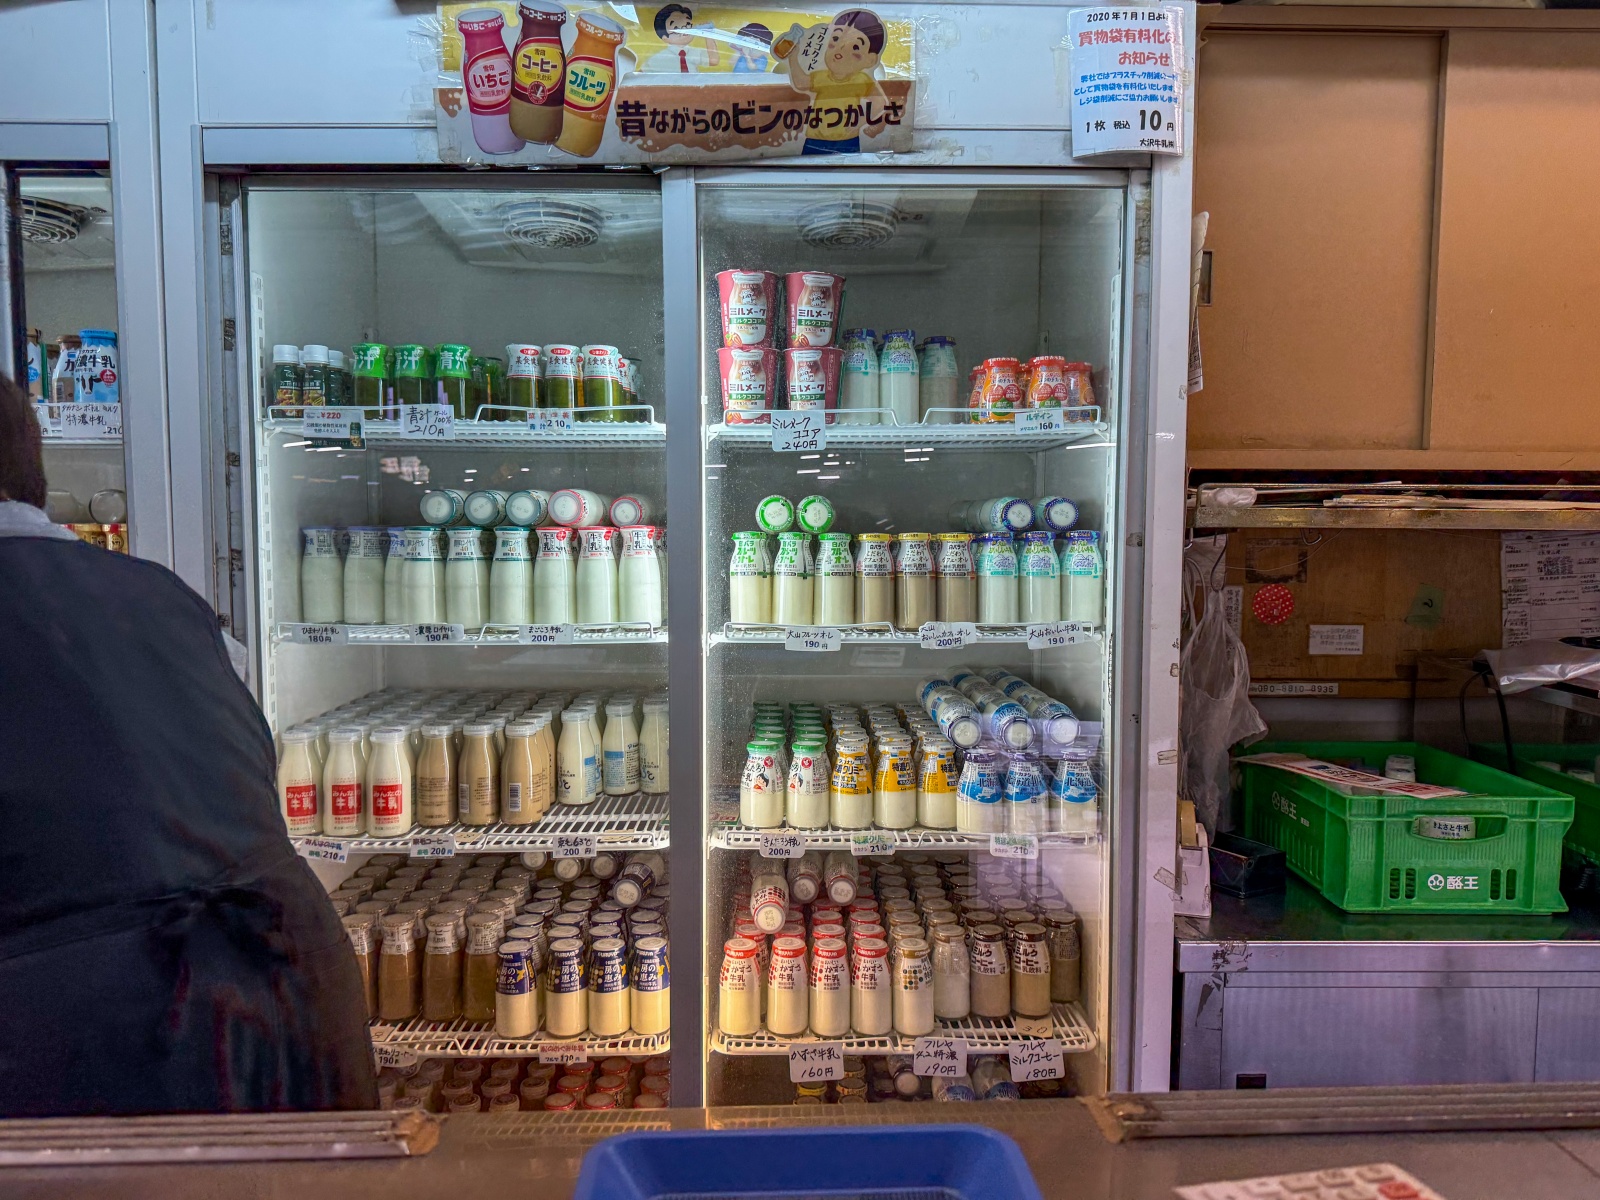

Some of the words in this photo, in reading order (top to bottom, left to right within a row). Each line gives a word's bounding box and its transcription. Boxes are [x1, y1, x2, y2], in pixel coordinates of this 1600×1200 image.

[522, 54, 558, 74] コーヒー
[1118, 50, 1170, 67] お知らせ
[473, 70, 510, 89] いちご
[568, 69, 607, 96] フルーツ
[617, 100, 903, 137] 昔ながらのビンのなつかしさ
[730, 307, 767, 317] ミルメーク
[798, 309, 834, 319] ミルメーク
[729, 384, 766, 392] ミルメーク
[1026, 412, 1054, 421] ルテイン
[772, 417, 811, 430] ミルメーク
[793, 429, 822, 440] ココア
[782, 440, 818, 451] 240円
[531, 635, 555, 643] 200円
[1047, 637, 1075, 645] 190円
[804, 641, 828, 650] 190円
[290, 797, 313, 809] 牛乳
[336, 797, 357, 809] 牛乳
[376, 797, 397, 810] 牛乳
[564, 848, 592, 856] 200円
[769, 848, 791, 856] 200円
[1447, 876, 1479, 890] 酪王
[971, 956, 993, 967] コーヒー
[1014, 956, 1039, 967] コーヒー
[729, 974, 746, 983] 牛乳
[778, 973, 795, 982] 牛乳
[823, 974, 840, 982] 牛乳
[861, 974, 877, 982] 牛乳
[924, 1040, 953, 1051] フルヤ
[1018, 1041, 1046, 1053] フルヤ
[1011, 1052, 1061, 1065] ミルクコーヒー
[801, 1067, 834, 1078] 160円
[925, 1063, 957, 1075] 190円
[1026, 1068, 1057, 1080] 180円
